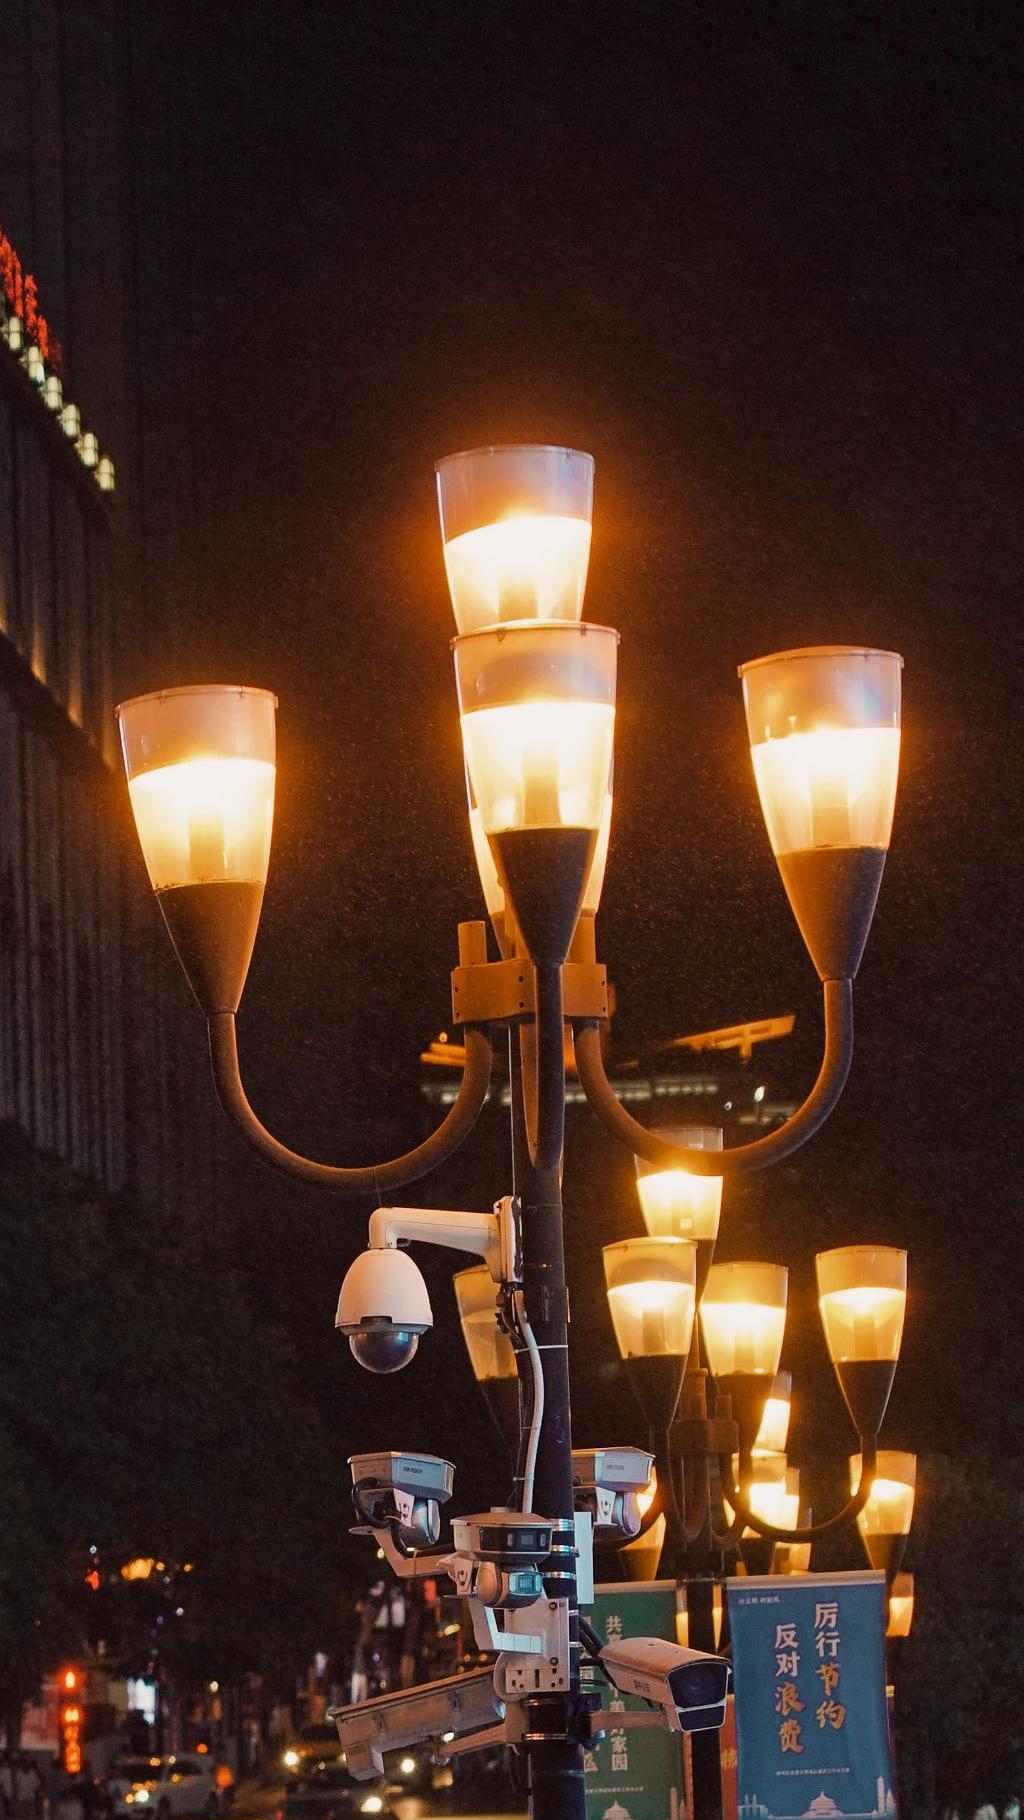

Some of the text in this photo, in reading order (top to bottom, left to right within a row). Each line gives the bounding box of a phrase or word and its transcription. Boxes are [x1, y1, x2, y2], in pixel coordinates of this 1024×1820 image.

[774, 1623, 806, 1753] 反对浪费
[814, 1602, 847, 1730] 厉行节约
